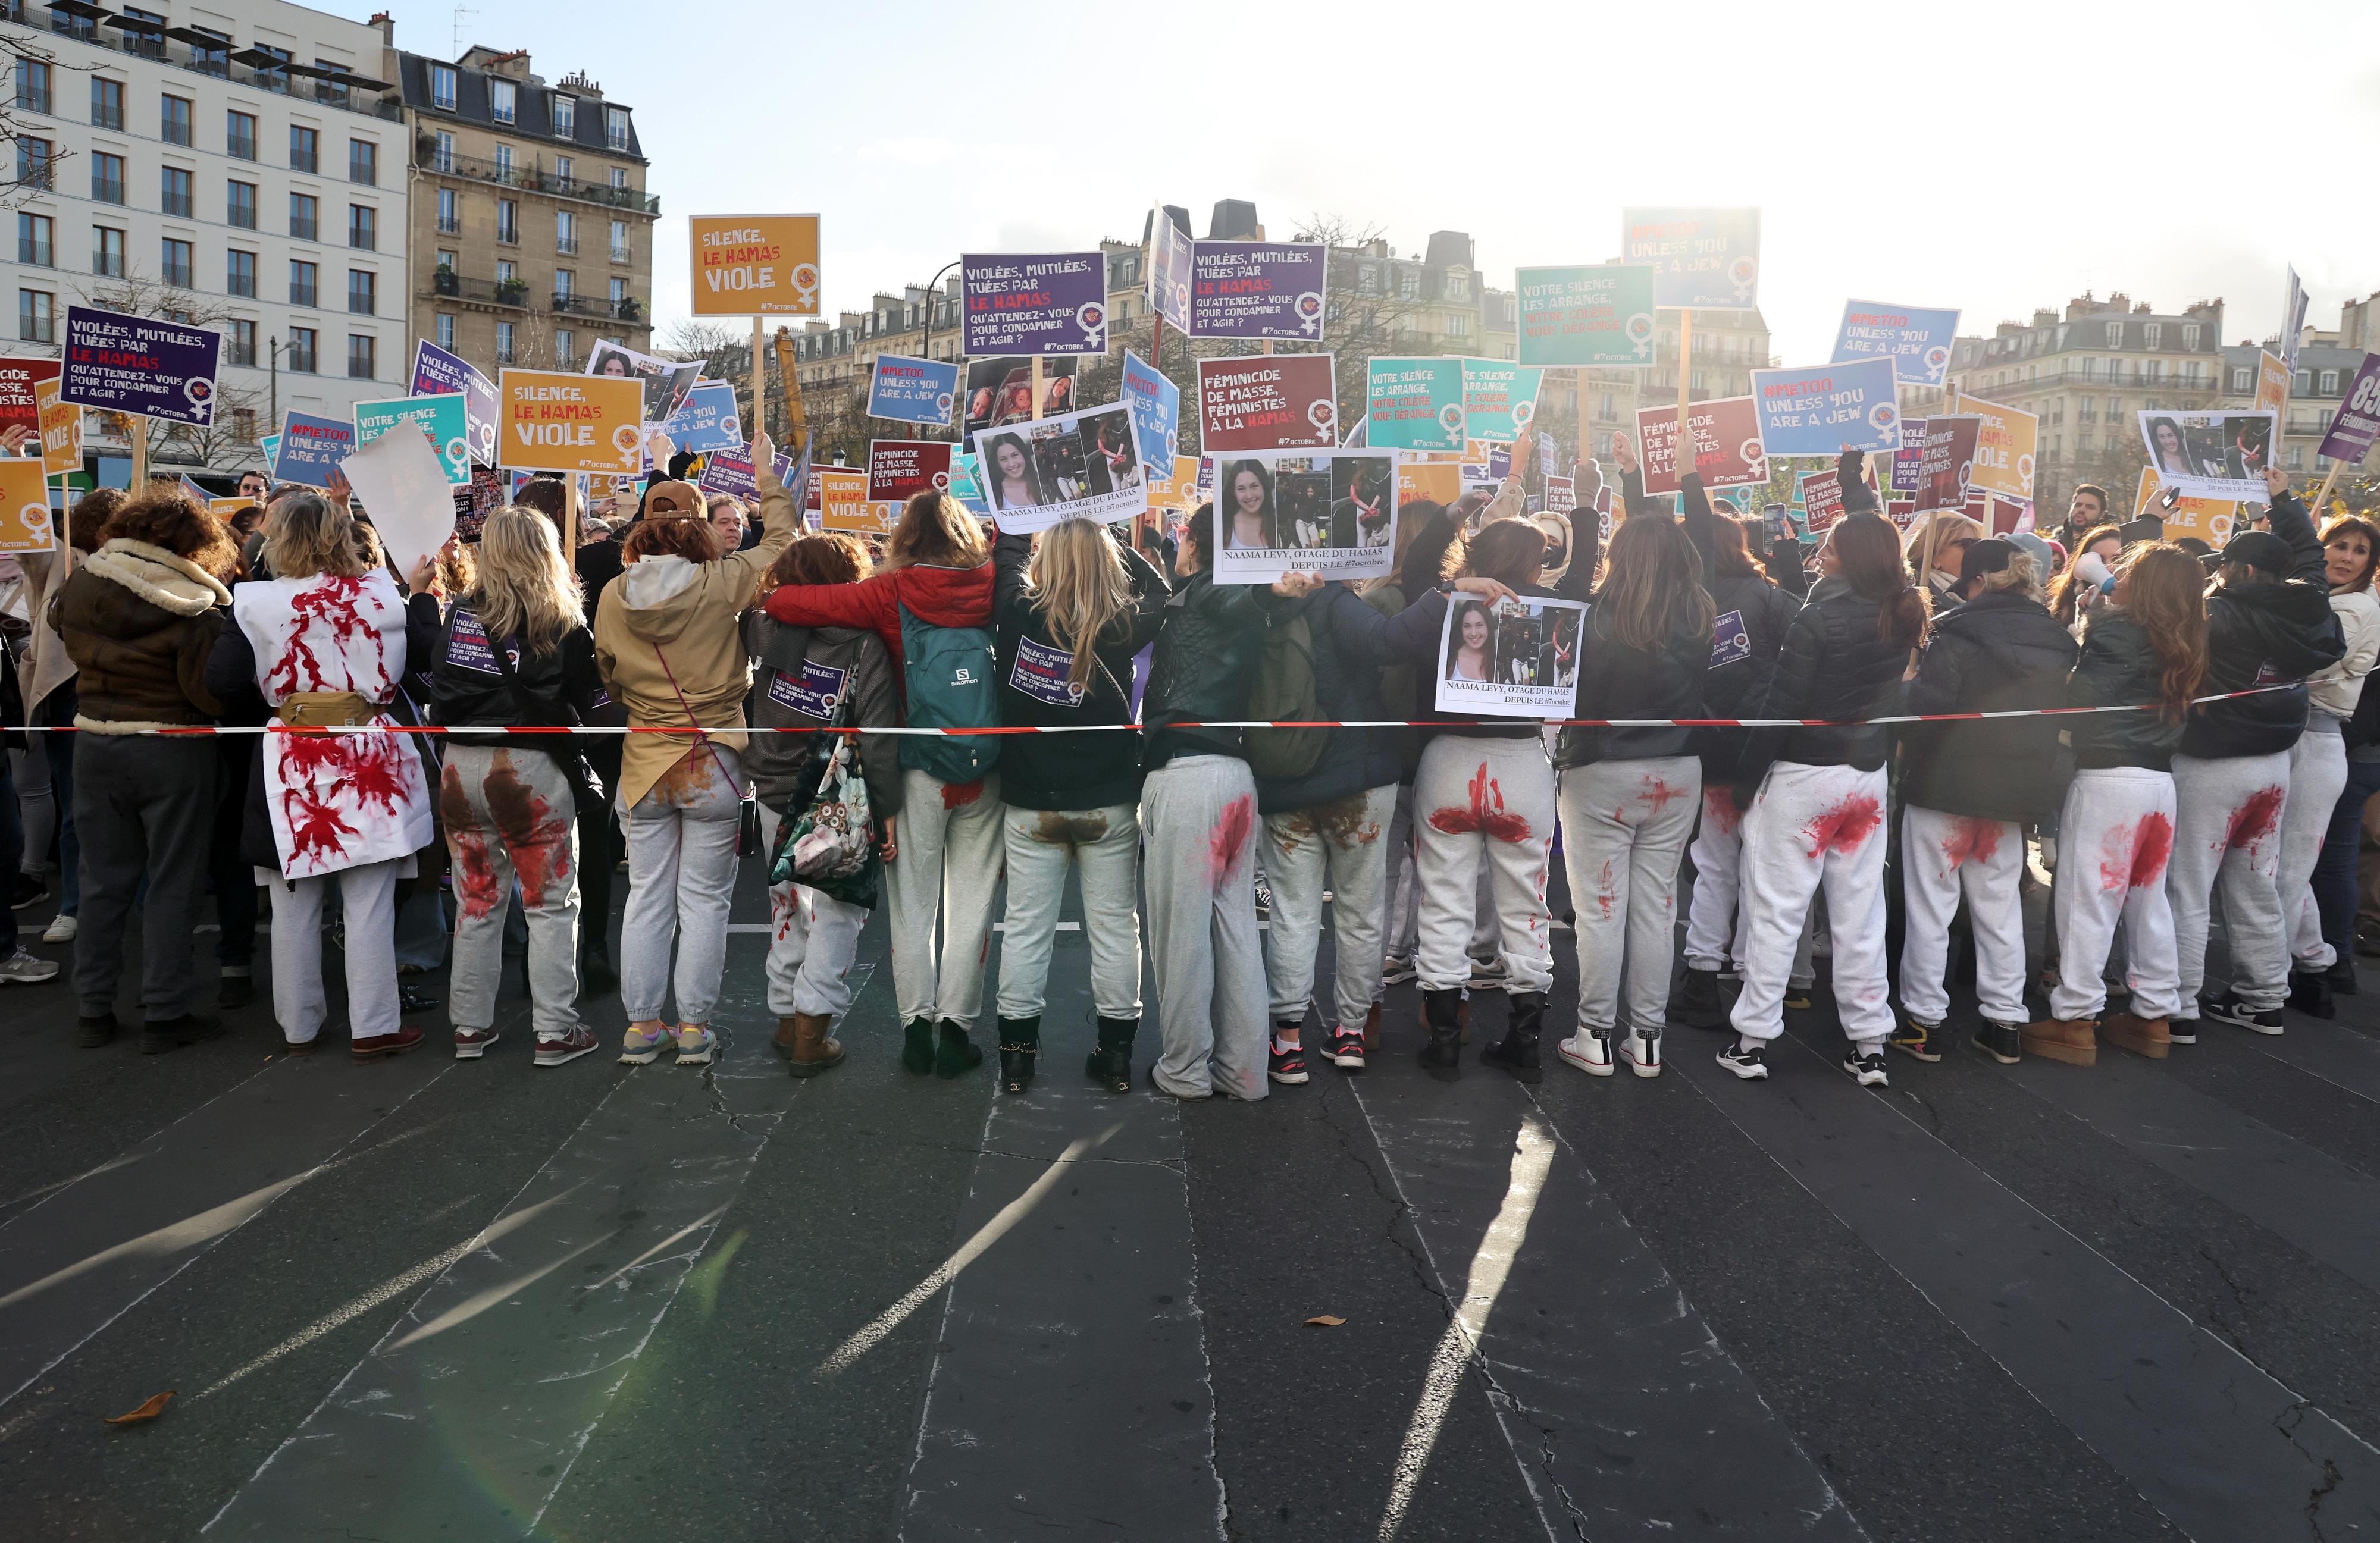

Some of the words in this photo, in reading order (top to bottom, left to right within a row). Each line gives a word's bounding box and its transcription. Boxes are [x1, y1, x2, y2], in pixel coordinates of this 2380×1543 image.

[703, 228, 765, 246] SILENCE,
[704, 251, 721, 266] LE
[726, 246, 780, 264] HAMAS
[1197, 252, 1247, 266] VIOLÉES,
[1251, 250, 1313, 264] MUTILÉES,
[966, 265, 1022, 280] VIOLÉES,
[1026, 260, 1091, 277] MUTILÉES,
[1197, 266, 1233, 279] TUÉES
[1238, 265, 1261, 277] PAR
[705, 266, 775, 292] VIOLE
[968, 280, 1008, 294] TUÉES
[1013, 278, 1038, 291] PAR
[1197, 282, 1214, 294] LE
[1220, 278, 1272, 293] HAMAS
[1523, 283, 1564, 297] VOTRE
[1567, 278, 1617, 292] SILENCE
[970, 297, 988, 311] LE
[994, 291, 1051, 309] HAMAS
[1523, 299, 1544, 311] LES
[1549, 293, 1612, 309] ARRANGE,
[1048, 308, 1074, 318] VOUS
[1197, 309, 1221, 318] POUR
[1225, 306, 1281, 316] CONDAMNER
[1525, 310, 1564, 324] NOTRE
[972, 325, 998, 335] POUR
[1002, 320, 1063, 333] CONDAMNER
[1197, 319, 1209, 328] ET
[1212, 318, 1234, 327] AGIR
[1238, 318, 1244, 327] ?
[1850, 313, 1908, 327] #METOO
[71, 320, 131, 339] VIOLÉES,
[137, 328, 205, 349] MUTILÉES,
[1262, 327, 1299, 335] #7OCTOBRE
[1527, 324, 1558, 338] VOUS
[1563, 319, 1621, 334] DÉRANGE
[1847, 327, 1895, 339] UNLESS
[1901, 330, 1928, 342] YOU
[72, 333, 115, 348] TUÉES
[121, 340, 148, 353] PAR
[973, 337, 985, 346] ET
[989, 335, 1013, 345] AGIR
[1017, 334, 1023, 343] ?
[1044, 343, 1084, 351] #7OCTOBRE
[1843, 340, 1872, 352] ARE
[1875, 342, 1887, 353] A
[1892, 344, 1923, 355] JEW
[71, 347, 92, 362] LE
[98, 351, 159, 369] HAMAS
[881, 366, 923, 377] #METOO
[1372, 374, 1397, 384] VOTRE
[1400, 370, 1434, 382] SILENCE
[71, 375, 100, 387] POUR
[104, 380, 170, 394] CONDAMNER
[155, 374, 183, 385] VOUS
[880, 377, 916, 388] UNLESS
[920, 380, 938, 389] YOU
[1204, 369, 1281, 390] FÉMINICIDE
[71, 387, 84, 395] ET
[89, 389, 115, 399] AGIR
[119, 391, 126, 400] ?
[515, 386, 586, 403] SILENCE,
[879, 388, 900, 398] ARE
[904, 390, 912, 399] A
[915, 391, 935, 400] JEW
[1207, 391, 1226, 403] DE
[1230, 385, 1279, 401] MASSE,
[1372, 387, 1384, 397] LES
[1387, 383, 1429, 396] ARRANGE,
[1764, 378, 1833, 397] #METOO
[1208, 397, 1286, 418] FÉMINISTES
[1372, 398, 1396, 409] NOTRE
[1399, 394, 1431, 406] COLÈRE
[1766, 396, 1824, 413] UNLESS
[1830, 388, 1864, 407] YOU
[147, 404, 188, 419] #7OCTOBRE
[515, 404, 533, 419] LE
[541, 405, 602, 419] HAMAS
[1372, 411, 1391, 421] VOUS
[1395, 407, 1436, 419] DÉRANGE
[1770, 415, 1802, 428] ARE
[1808, 413, 1821, 426] A
[1825, 406, 1861, 424] JEW
[1211, 418, 1221, 432] À
[1226, 417, 1243, 430] LA
[1248, 411, 1296, 428] HAMAS
[515, 422, 595, 446] VIOLE
[1278, 437, 1316, 446] #7OCTOBRE
[1413, 439, 1445, 447] #7OCTOBRE
[875, 450, 919, 460] FÉMINICIDE
[578, 459, 618, 469] #7OCTOBRE
[874, 469, 919, 478] FÉMINISTES
[874, 479, 880, 488] À
[1001, 508, 1032, 518] NAAMA
[1034, 505, 1059, 515] LEVY,
[1060, 500, 1091, 510] OTAGE
[1107, 488, 1136, 501] HAMAS
[1060, 509, 1092, 520] DEPUIS
[1225, 550, 1261, 560] NAAMA
[1264, 550, 1292, 560] LEVY,
[1294, 549, 1329, 559] OTAGE
[1332, 550, 1346, 558] DU
[1349, 548, 1382, 557] HAMAS
[1291, 560, 1327, 569] DEPUIS
[1330, 560, 1342, 569] LE
[1345, 559, 1385, 568] #7octobre
[1020, 651, 1037, 664] TUÉES
[1039, 659, 1053, 668] PAR
[1022, 644, 1046, 660] VIOLÉES,
[1016, 673, 1028, 682] POUR
[1029, 679, 1060, 691] CONDAMNER
[1446, 682, 1479, 691] NAAMA
[1482, 684, 1506, 694] LEVY,
[1508, 686, 1535, 695] OTAGE
